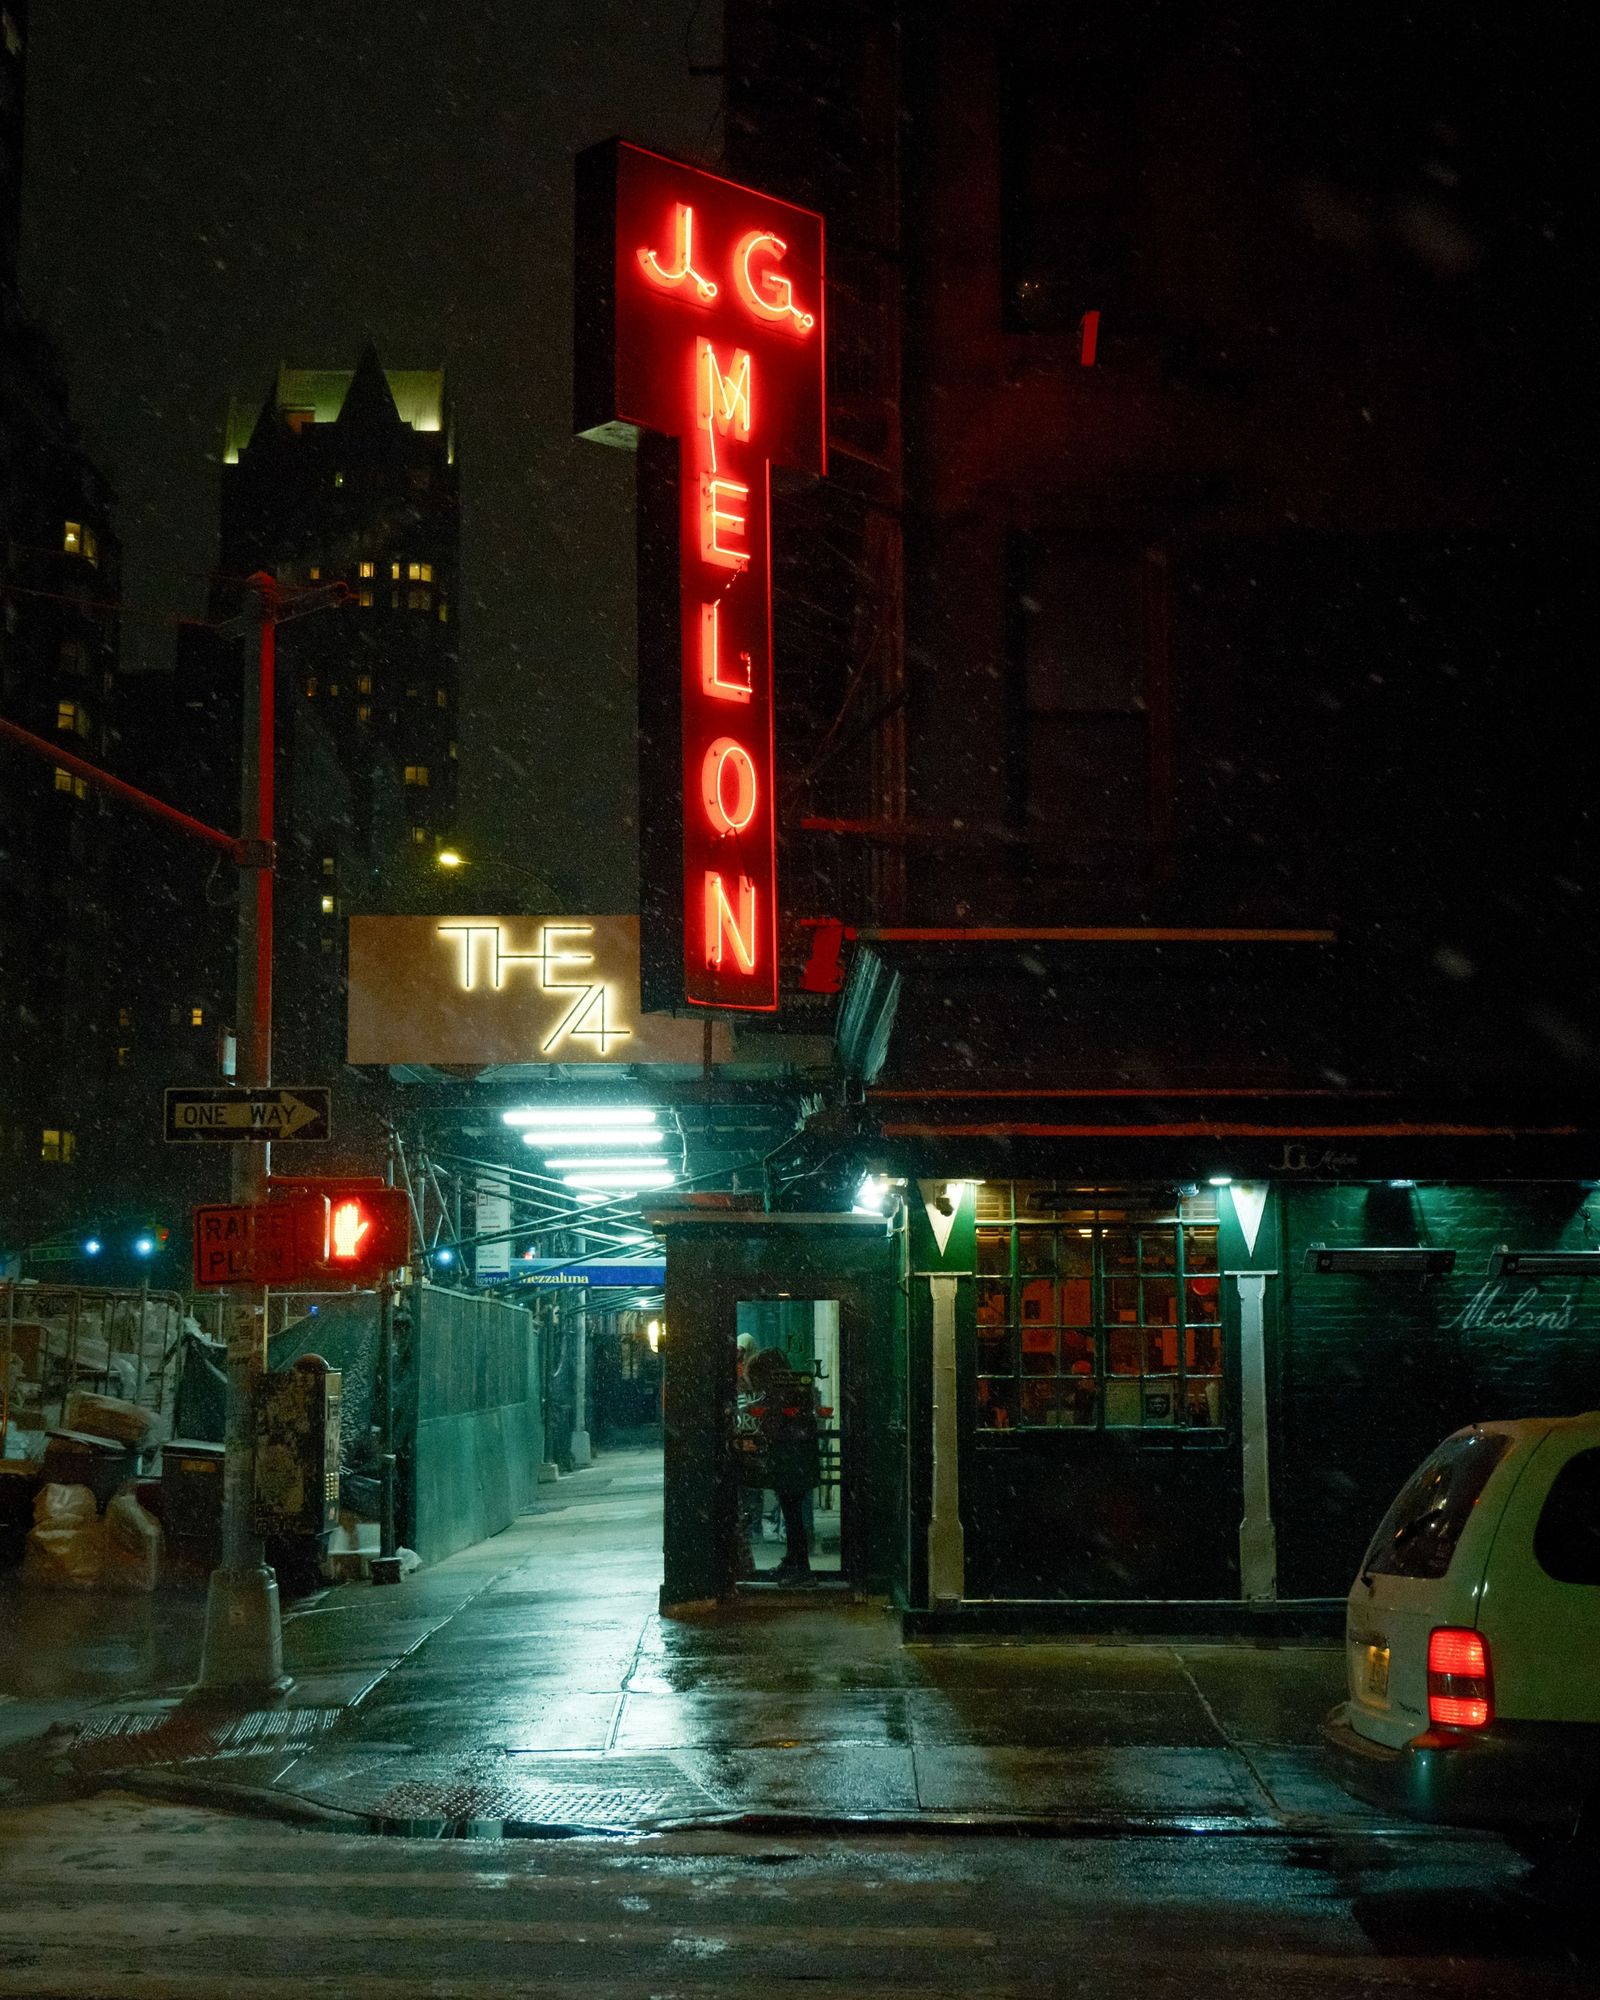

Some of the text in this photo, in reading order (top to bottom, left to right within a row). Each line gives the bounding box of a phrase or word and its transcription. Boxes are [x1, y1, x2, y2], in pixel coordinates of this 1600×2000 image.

[696, 336, 758, 977] MELON
[437, 925, 593, 988] THE
[541, 984, 632, 1053] 74
[183, 1104, 297, 1125] ONE WAY
[519, 1271, 589, 1285] Mezzaluna
[1438, 1281, 1579, 1330] Melon's
